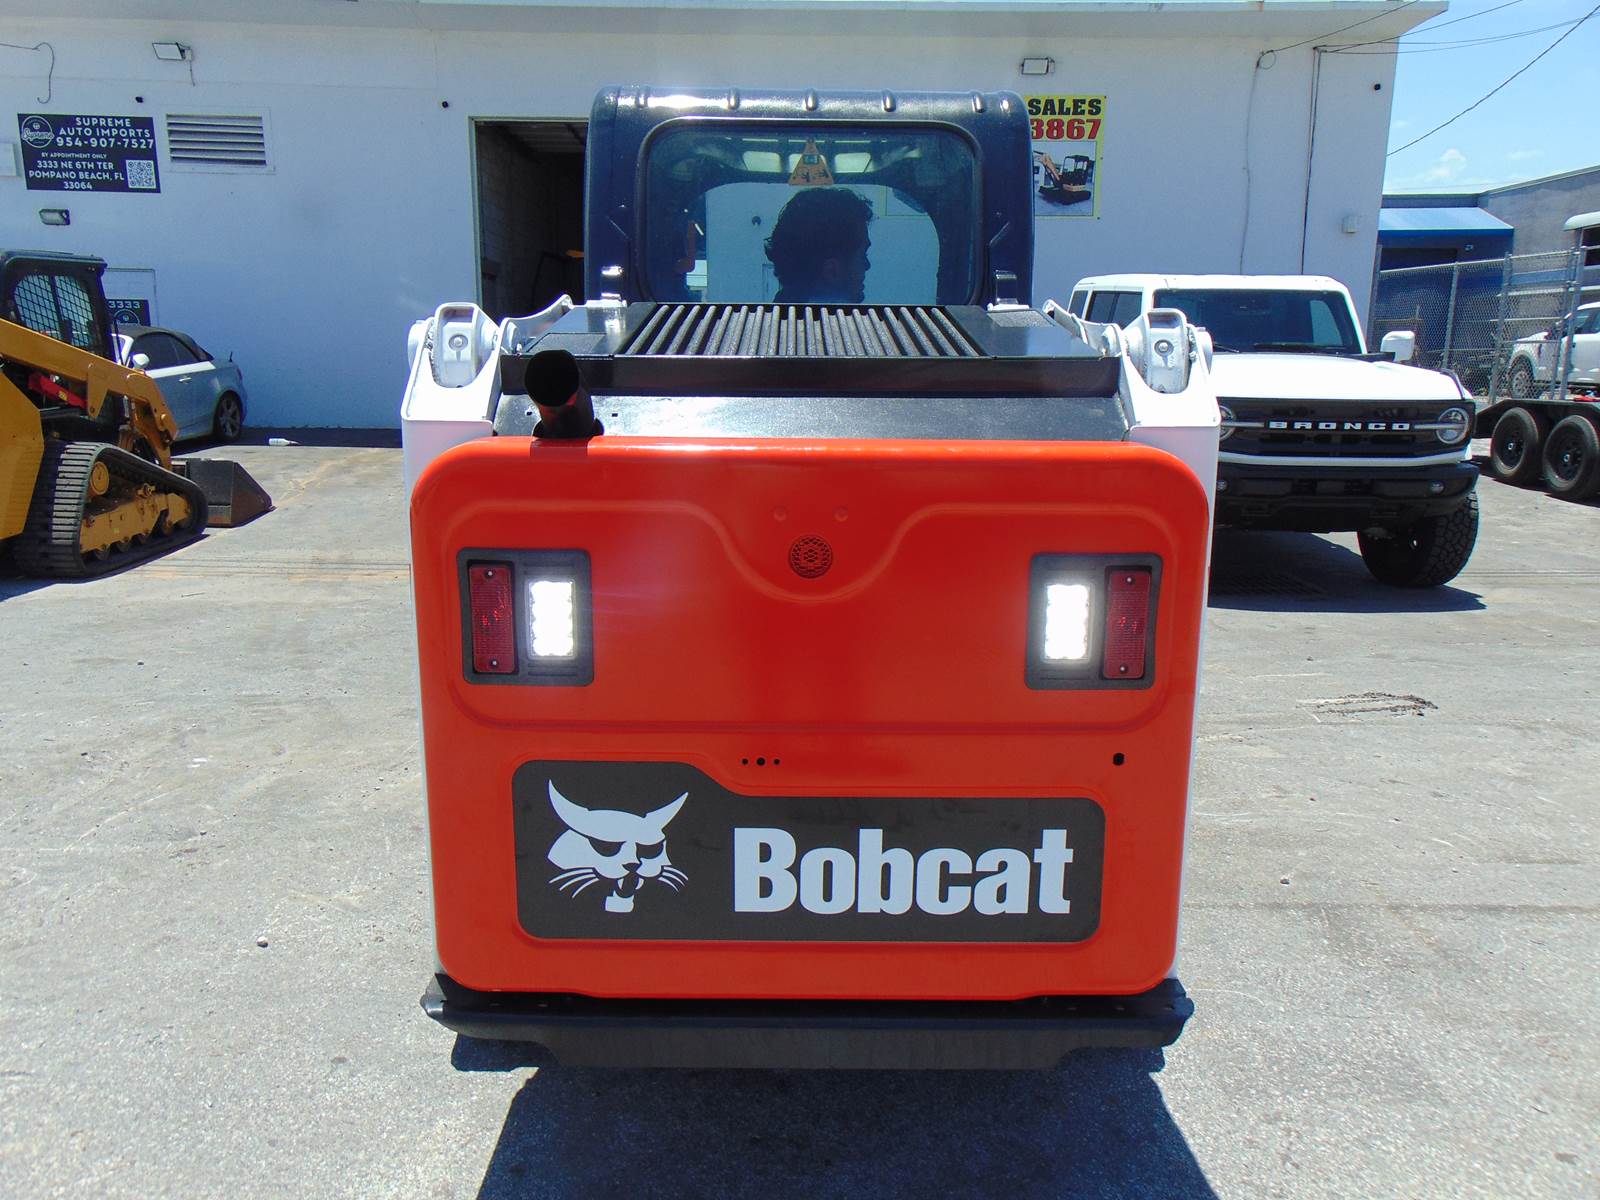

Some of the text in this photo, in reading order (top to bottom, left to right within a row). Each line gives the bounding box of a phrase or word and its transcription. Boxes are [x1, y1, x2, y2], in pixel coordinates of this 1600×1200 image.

[1027, 98, 1102, 116] SALES
[75, 117, 132, 127] SUPREME
[59, 127, 151, 138] AUTO IMPORTS
[1029, 118, 1102, 140] 3867
[56, 137, 154, 149] 954-907-7527
[37, 160, 114, 170] 3333 NE 6TH TER
[28, 170, 124, 180] POMPANO BEACH, FL
[64, 181, 92, 190] 33064
[108, 300, 140, 309] 3333
[1269, 421, 1410, 431] BRONCO
[733, 827, 1074, 916] Bobcat
